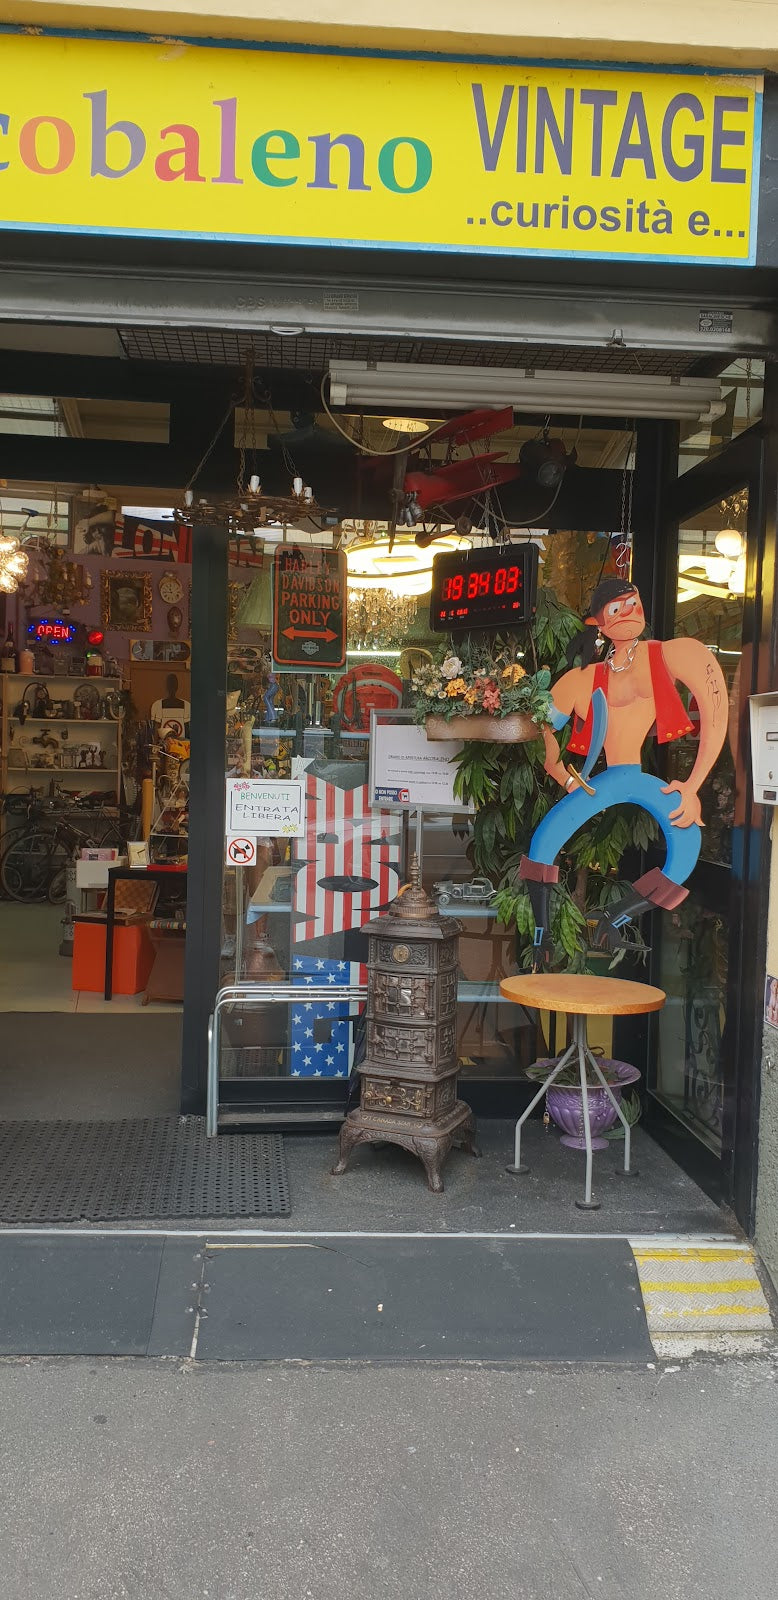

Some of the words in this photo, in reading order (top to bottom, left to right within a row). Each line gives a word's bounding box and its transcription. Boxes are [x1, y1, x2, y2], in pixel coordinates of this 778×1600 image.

[0, 89, 433, 195] obaleno
[472, 84, 749, 185] VINTAGE
[467, 196, 673, 236] ..curiosità
[688, 210, 746, 239] e...
[282, 575, 340, 593] DAVIDSON
[282, 591, 340, 610] PARKING
[290, 610, 331, 626] ONLY
[37, 624, 70, 639] OPEN
[240, 792, 290, 801] BENVENUTI
[235, 803, 299, 814] ENTRATA
[243, 812, 291, 822] LIBERA
